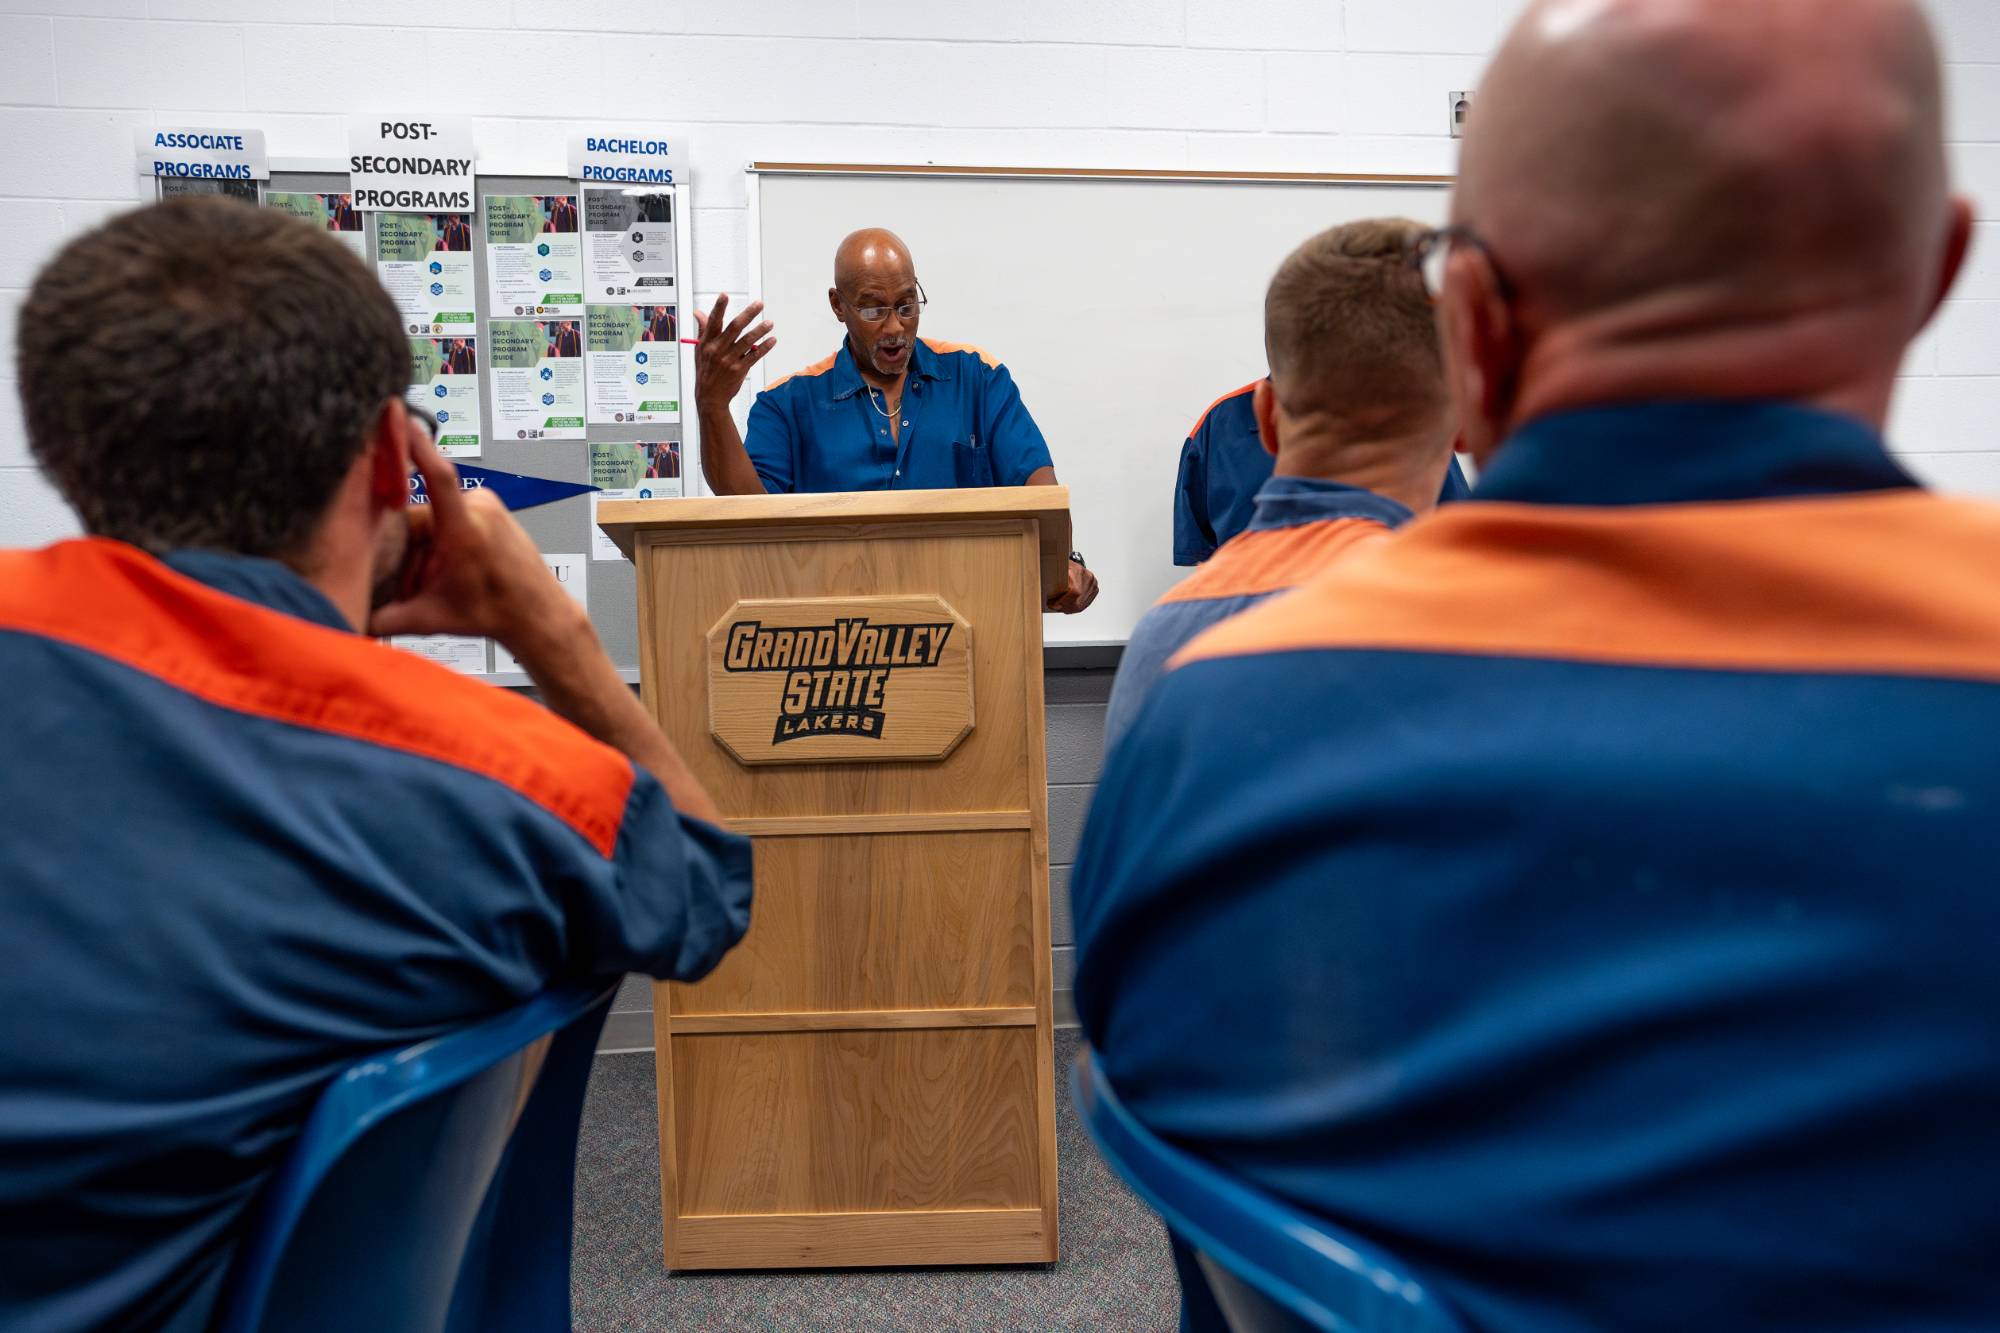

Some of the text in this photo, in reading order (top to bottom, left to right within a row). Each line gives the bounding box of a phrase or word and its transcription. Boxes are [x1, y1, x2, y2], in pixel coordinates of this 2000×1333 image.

[380, 122, 437, 140] POST-
[154, 132, 243, 150] ASSOCIATE
[586, 137, 668, 156] BACHELOR
[153, 161, 251, 179] PROGRAMS
[351, 156, 471, 176] SECONDARY
[583, 165, 673, 183] PROGRAMS
[355, 190, 470, 208] PROGRAMS
[783, 668, 889, 714] STATE
[783, 714, 875, 735] LAKERS
